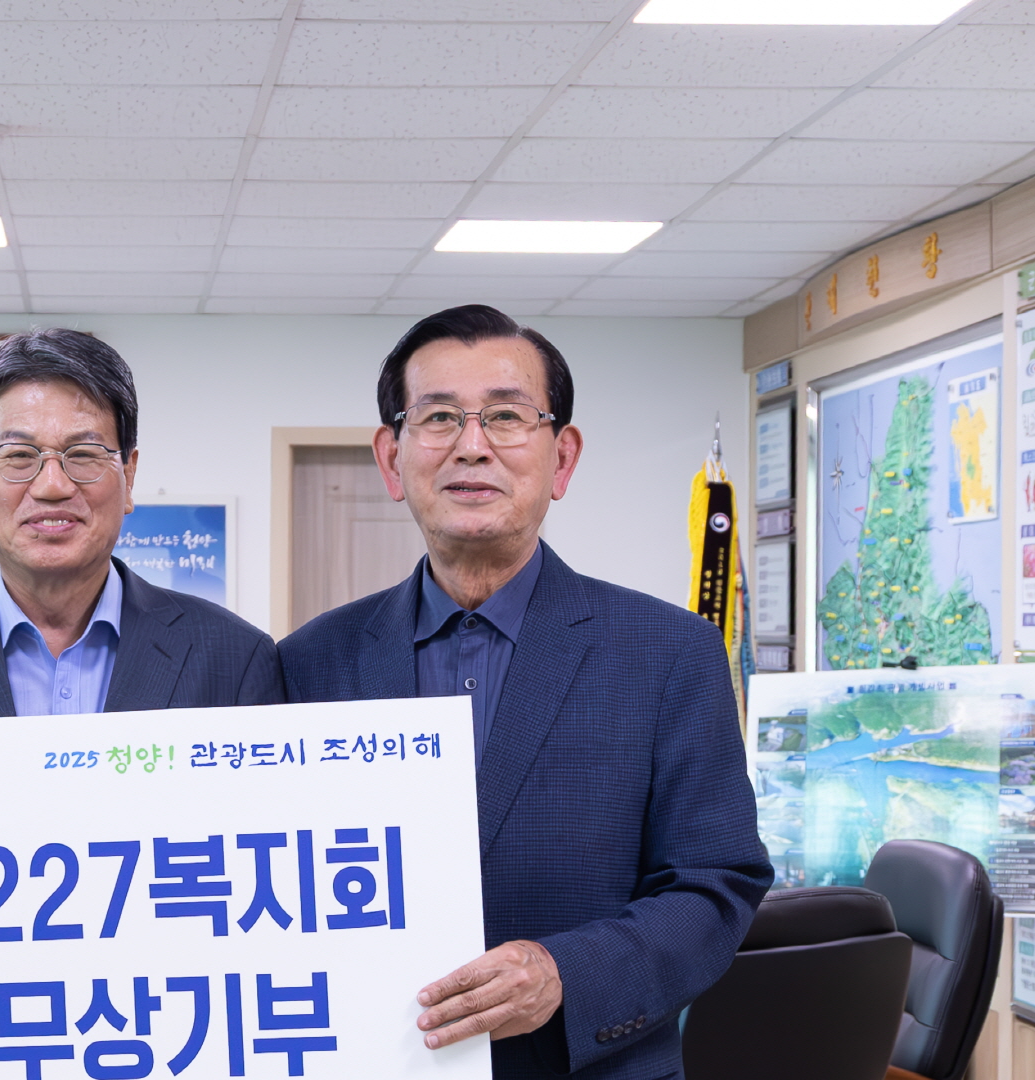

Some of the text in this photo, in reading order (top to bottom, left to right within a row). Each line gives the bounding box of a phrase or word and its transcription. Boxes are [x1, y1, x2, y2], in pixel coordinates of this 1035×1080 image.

[44, 751, 100, 769] 2025
[106, 744, 175, 774] 청양!
[189, 738, 306, 769] 관광도시
